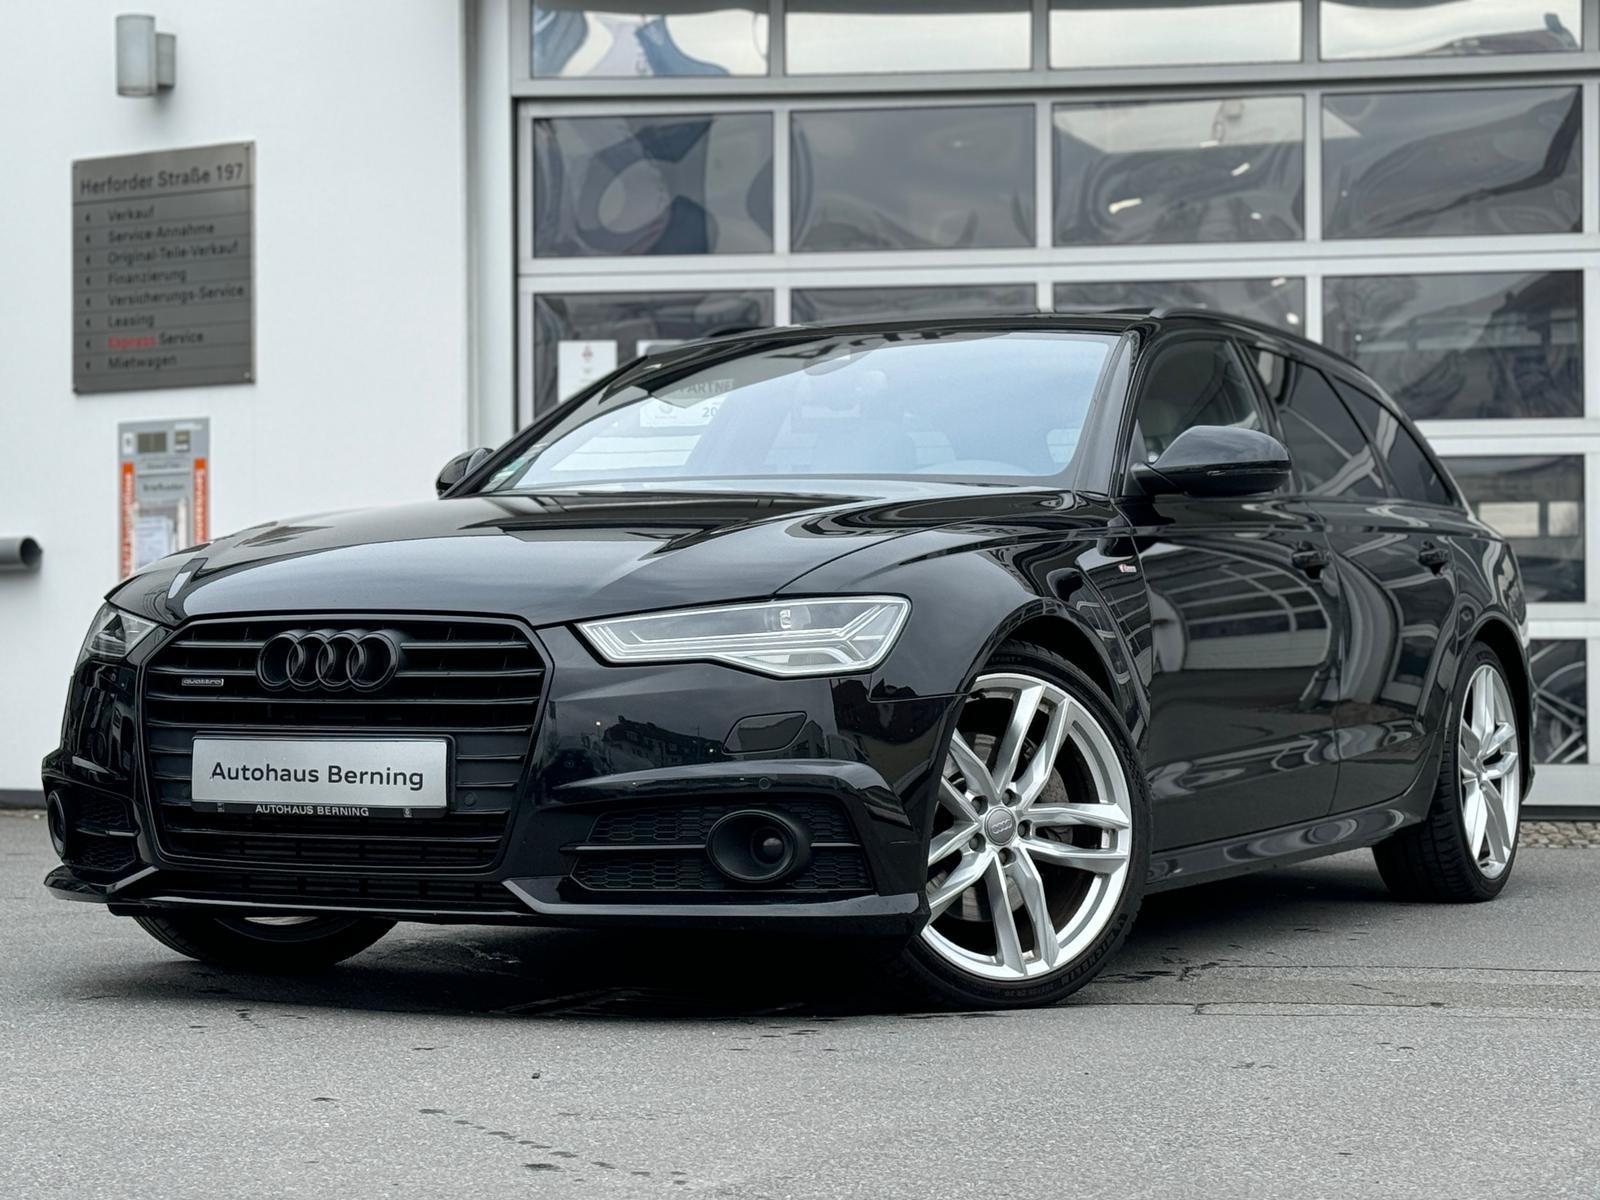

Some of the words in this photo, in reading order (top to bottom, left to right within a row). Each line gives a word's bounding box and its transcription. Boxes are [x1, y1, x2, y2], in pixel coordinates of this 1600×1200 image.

[80, 174, 153, 195] Herforder
[157, 166, 211, 187] Straße
[216, 163, 243, 181] 197
[108, 205, 155, 221] Verkauf
[108, 269, 187, 285] Finanzierung
[108, 313, 155, 328] Leasing
[108, 354, 177, 370] Mietwagen
[183, 678, 222, 686] quattro
[211, 761, 320, 783] Autohaus
[327, 765, 424, 791] Berning
[255, 804, 314, 815] AUTOHAUS
[317, 806, 369, 817] BERNING
